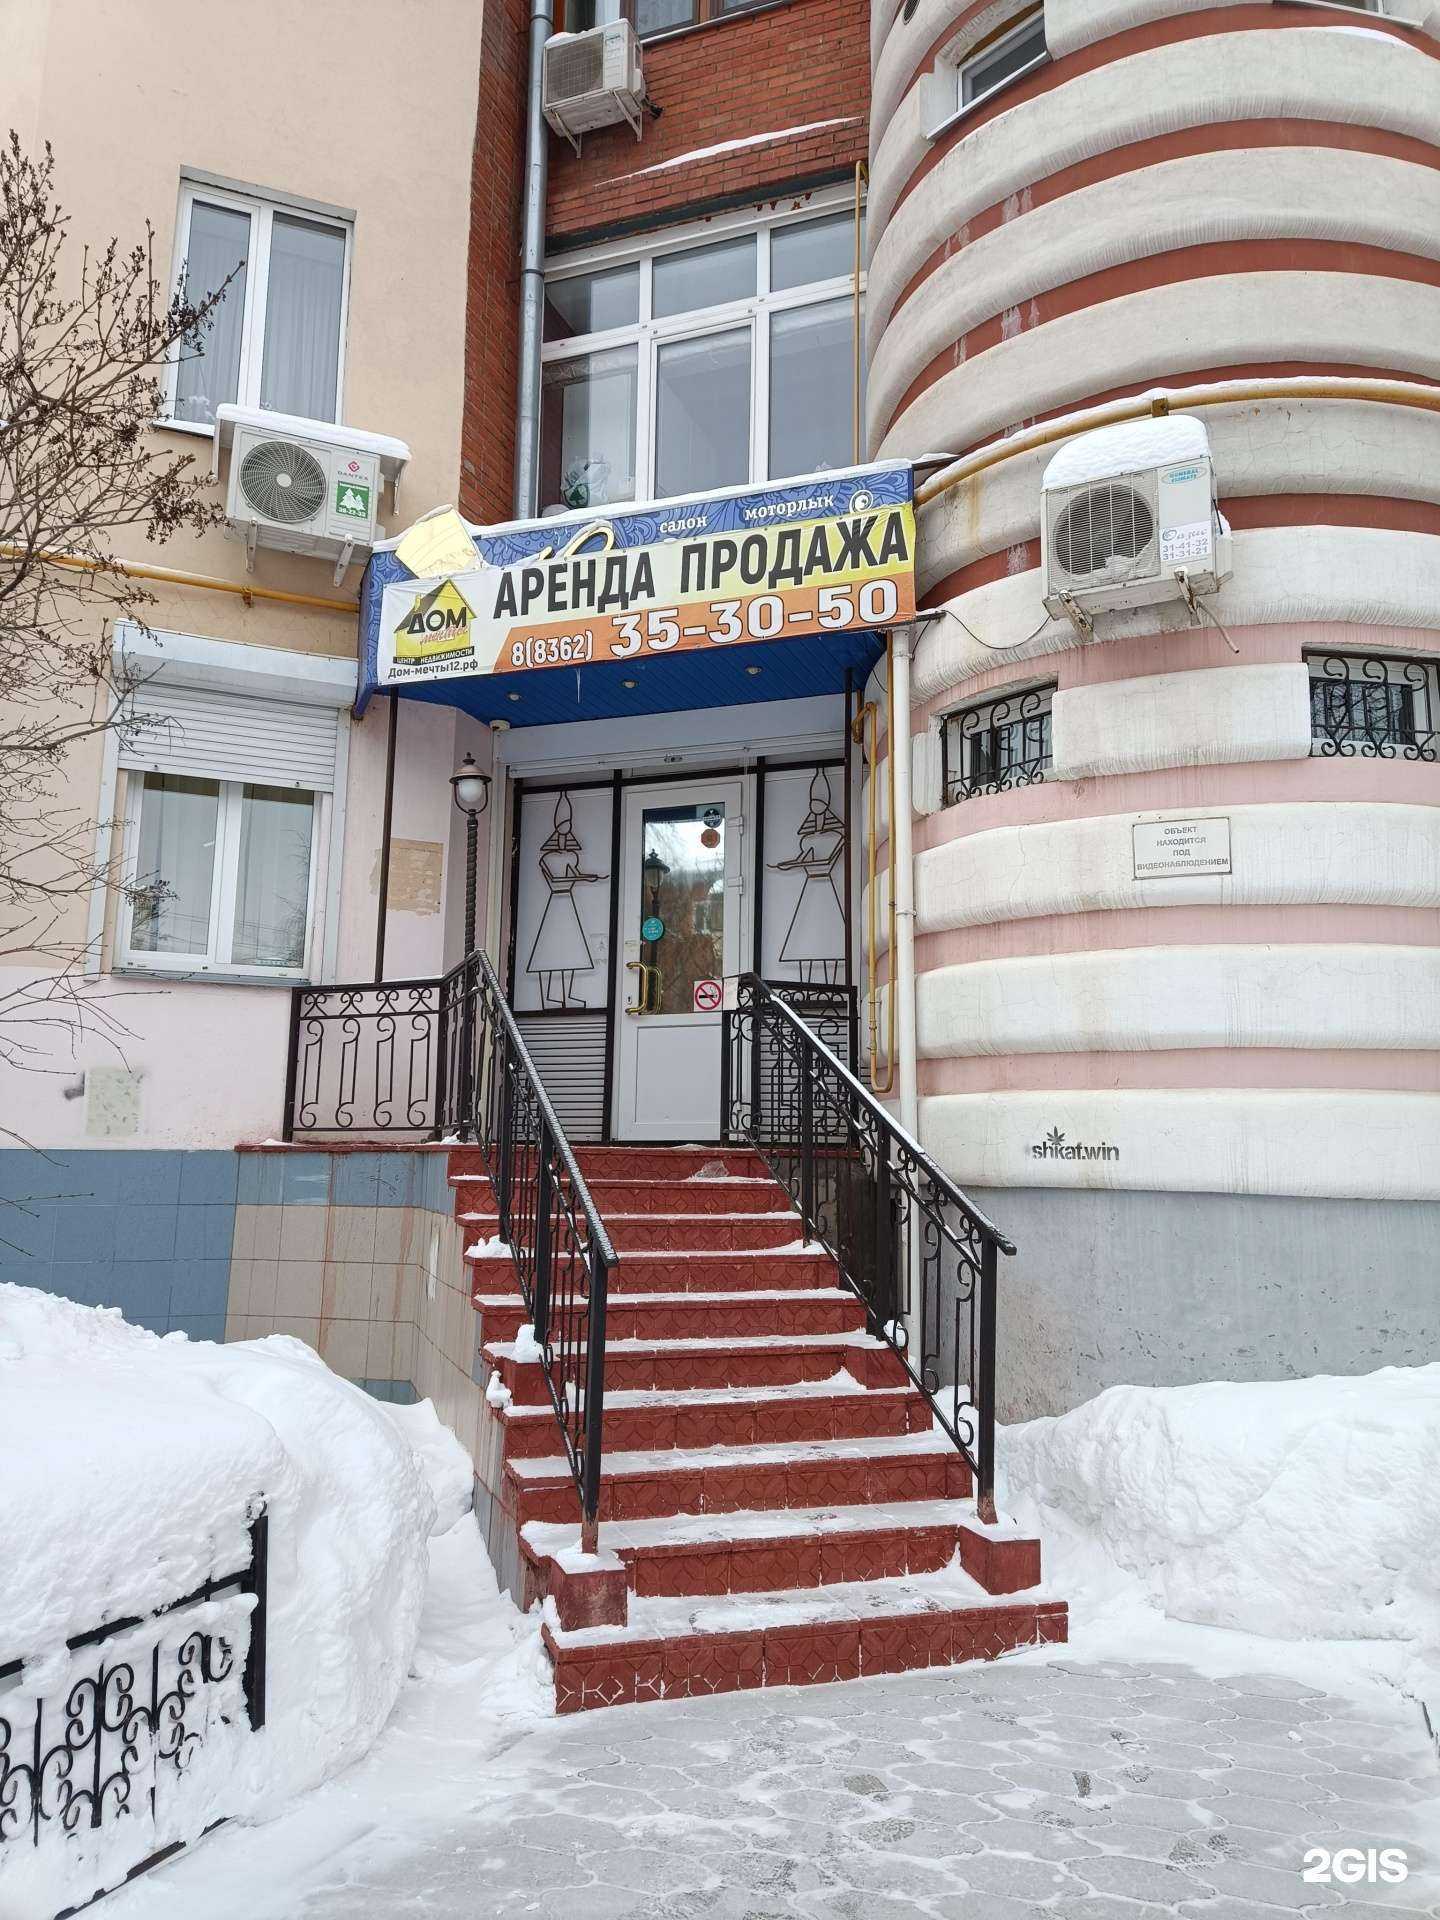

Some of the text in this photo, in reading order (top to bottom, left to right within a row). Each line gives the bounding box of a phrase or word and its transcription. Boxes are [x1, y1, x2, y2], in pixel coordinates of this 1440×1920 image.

[744, 494, 835, 521] моторлык
[659, 514, 708, 533] салон
[493, 552, 656, 620] АРЕНДА
[680, 512, 909, 594] ПРОДАЖА
[407, 607, 467, 634] ДОМ
[511, 579, 899, 668] 8(8362) 35-30-50
[420, 648, 473, 664] НЕДВИЖИМОСТИ
[387, 659, 479, 679] Дом-мечты12.рф
[1164, 826, 1197, 835] ОБЪЕКТ
[1156, 837, 1207, 847] НАХОДИТСЯ
[1173, 849, 1191, 857] ПОД
[1137, 858, 1229, 871] ВИДЕОНАБЛЮДЕНИЕМ
